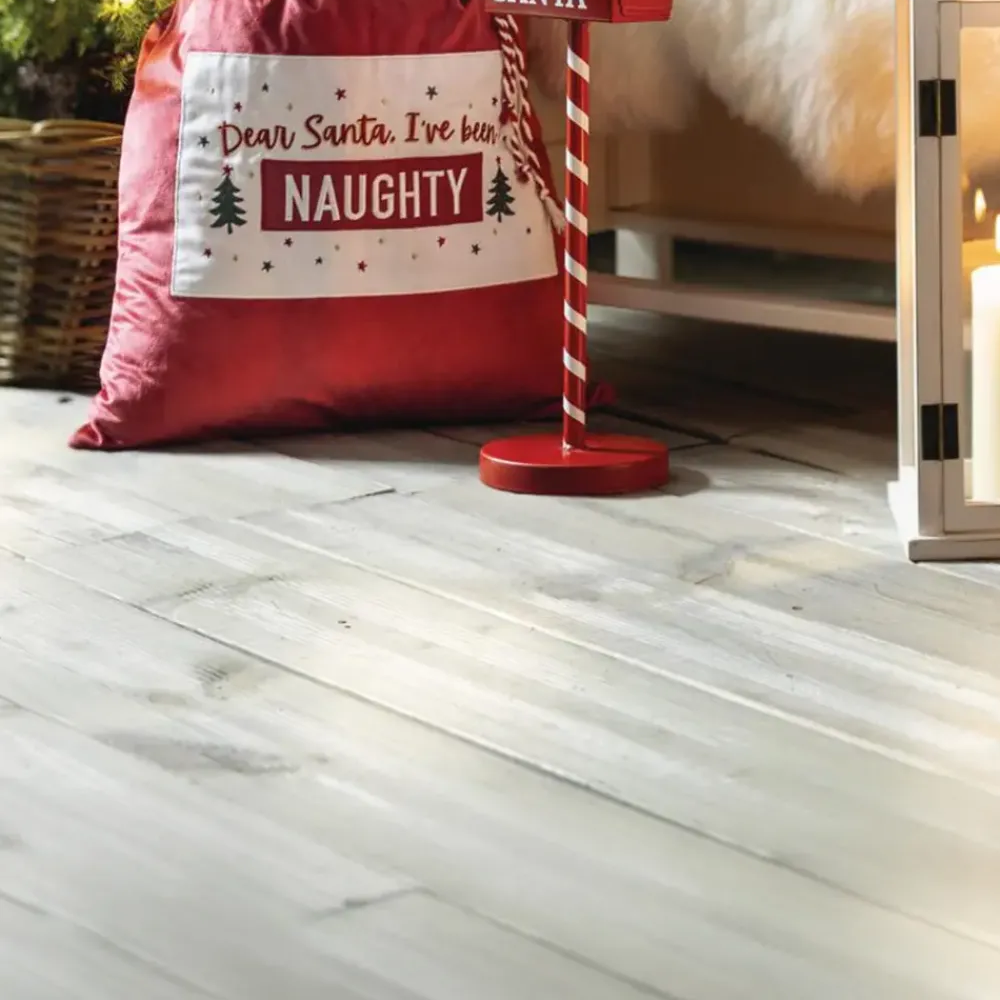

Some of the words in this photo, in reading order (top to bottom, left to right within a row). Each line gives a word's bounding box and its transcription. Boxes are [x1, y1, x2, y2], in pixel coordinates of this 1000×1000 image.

[218, 120, 296, 156] Dear
[404, 111, 455, 144] I've
[461, 114, 498, 145] been
[284, 167, 468, 223] NAUGHTY
